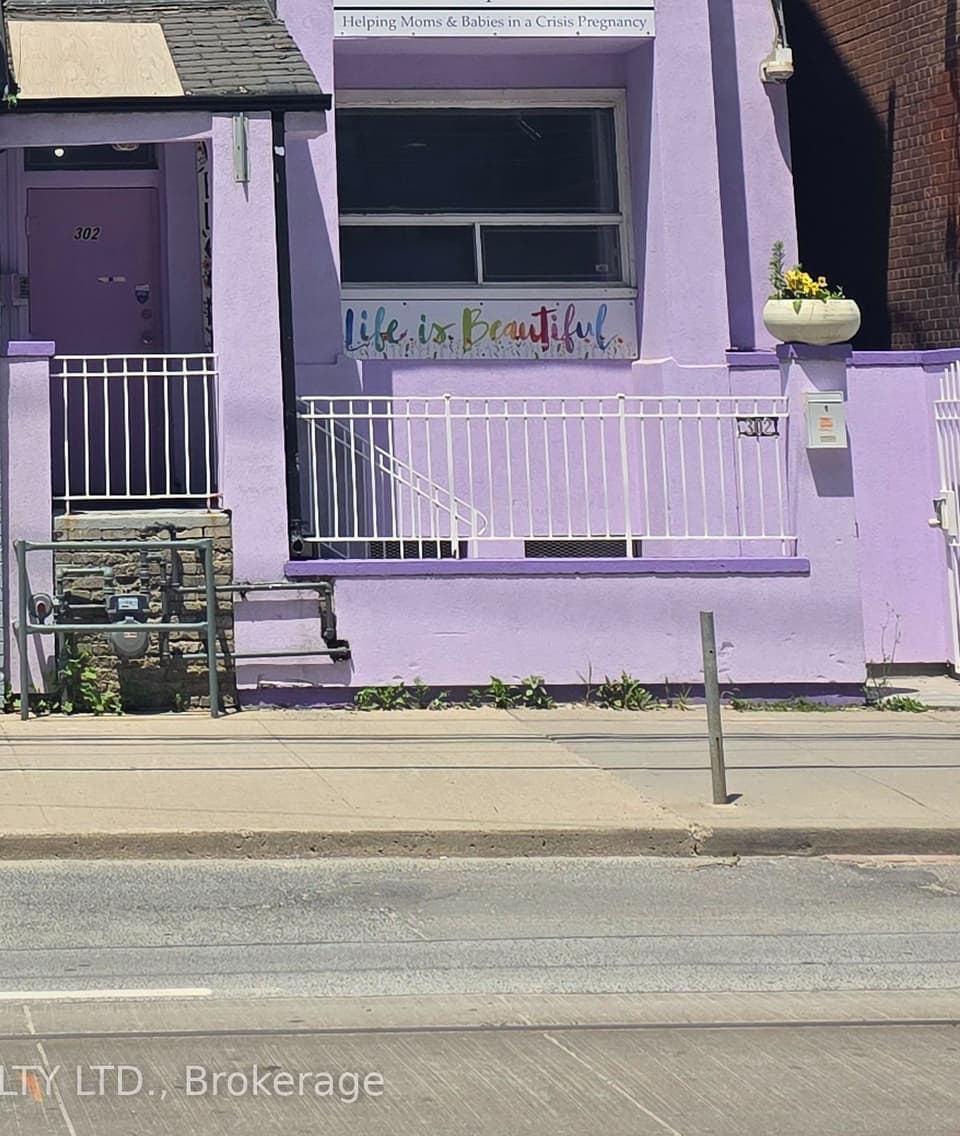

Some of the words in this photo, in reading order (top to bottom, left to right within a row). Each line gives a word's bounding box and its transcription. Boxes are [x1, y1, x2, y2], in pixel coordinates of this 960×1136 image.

[342, 15, 397, 31] Helping
[401, 16, 442, 28] Moms
[446, 16, 457, 28] &
[461, 15, 505, 28] Babies
[508, 15, 522, 28] in
[524, 19, 533, 28] a
[536, 15, 574, 28] Crisis
[578, 15, 648, 32] Pregnancy
[74, 226, 101, 241] 302
[345, 306, 407, 353] Life
[418, 313, 456, 345] is
[462, 303, 618, 354] Beautiful
[746, 418, 773, 436] 302
